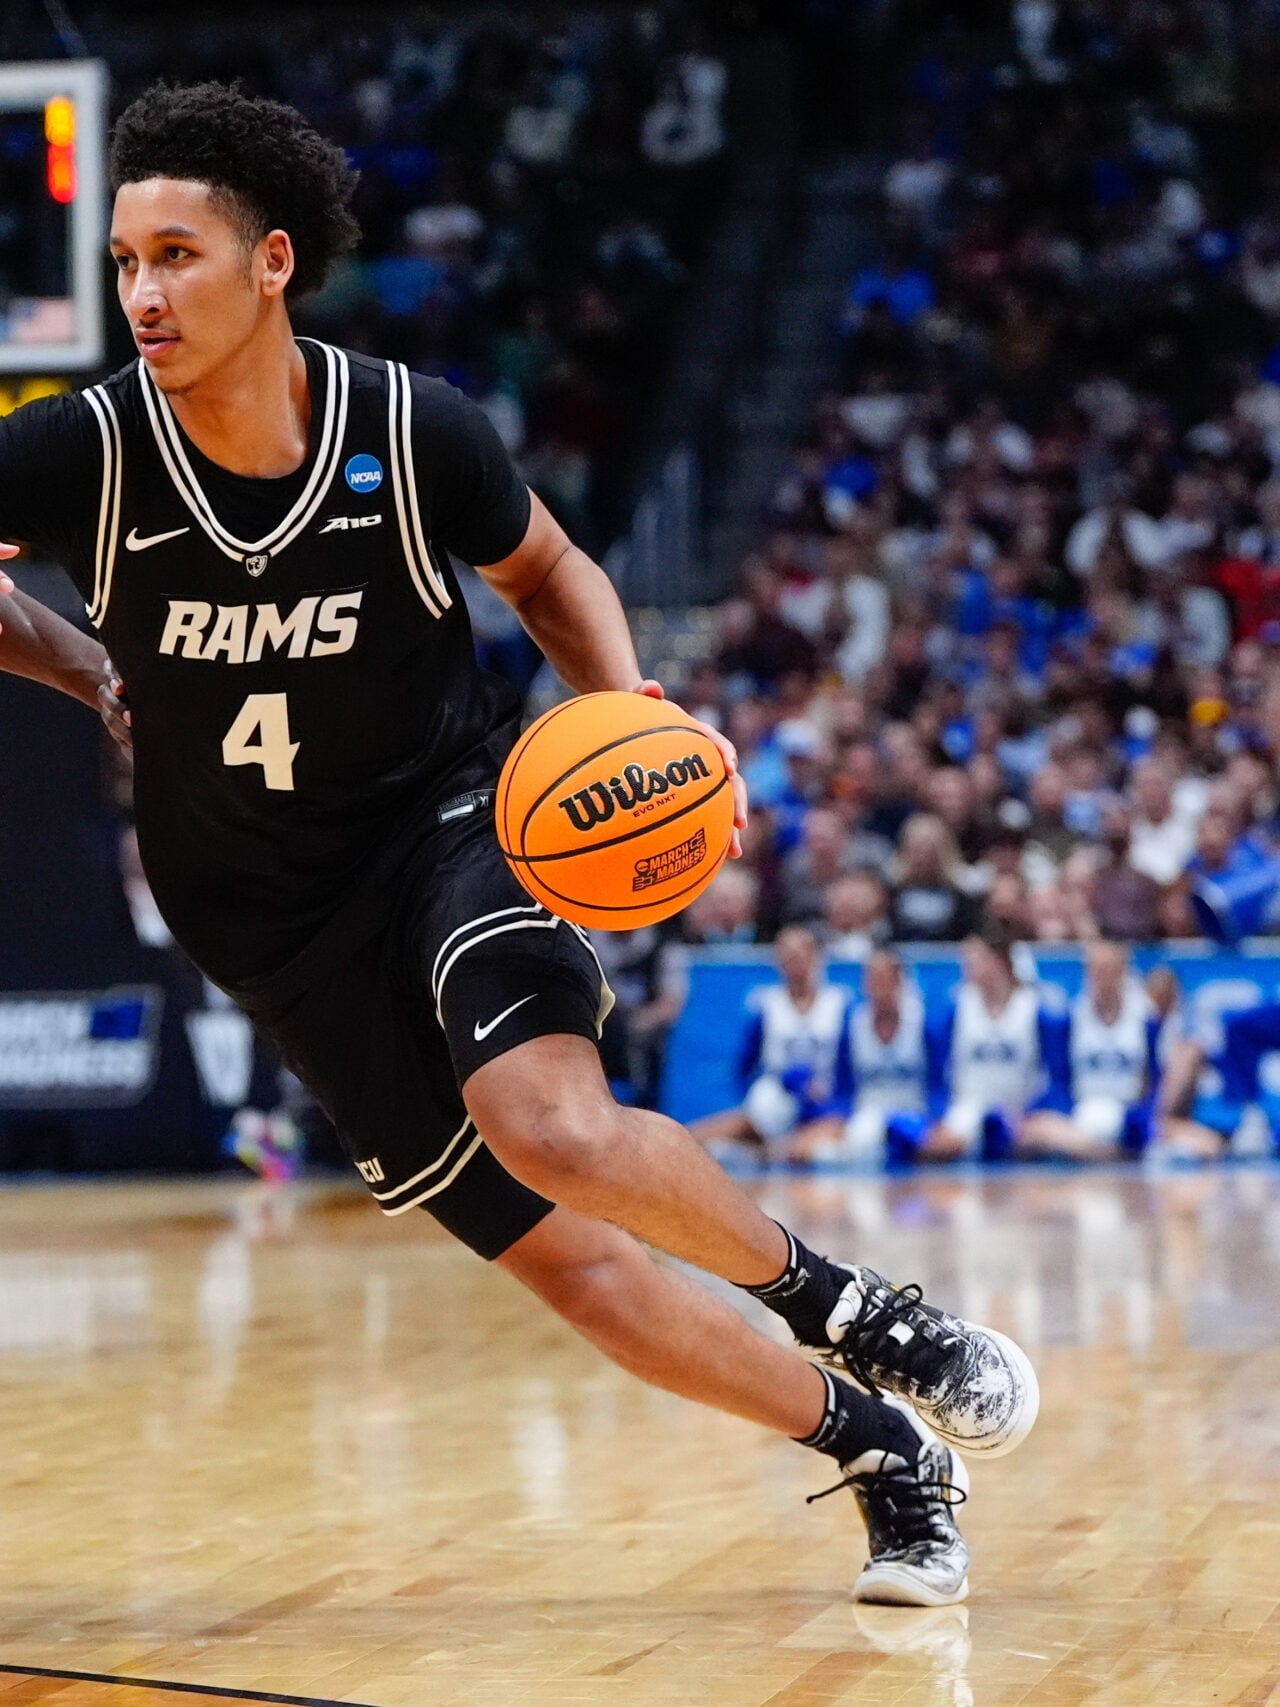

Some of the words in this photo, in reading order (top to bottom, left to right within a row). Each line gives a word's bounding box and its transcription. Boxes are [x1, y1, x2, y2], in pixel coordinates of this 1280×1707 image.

[350, 470, 382, 485] NCAA
[158, 590, 363, 664] RAMS
[221, 692, 301, 792] 4
[558, 752, 711, 832] Wilson
[632, 803, 655, 818] EVO
[656, 793, 677, 807] NXT
[649, 842, 689, 872] MARCH
[656, 843, 706, 880] MADNESS
